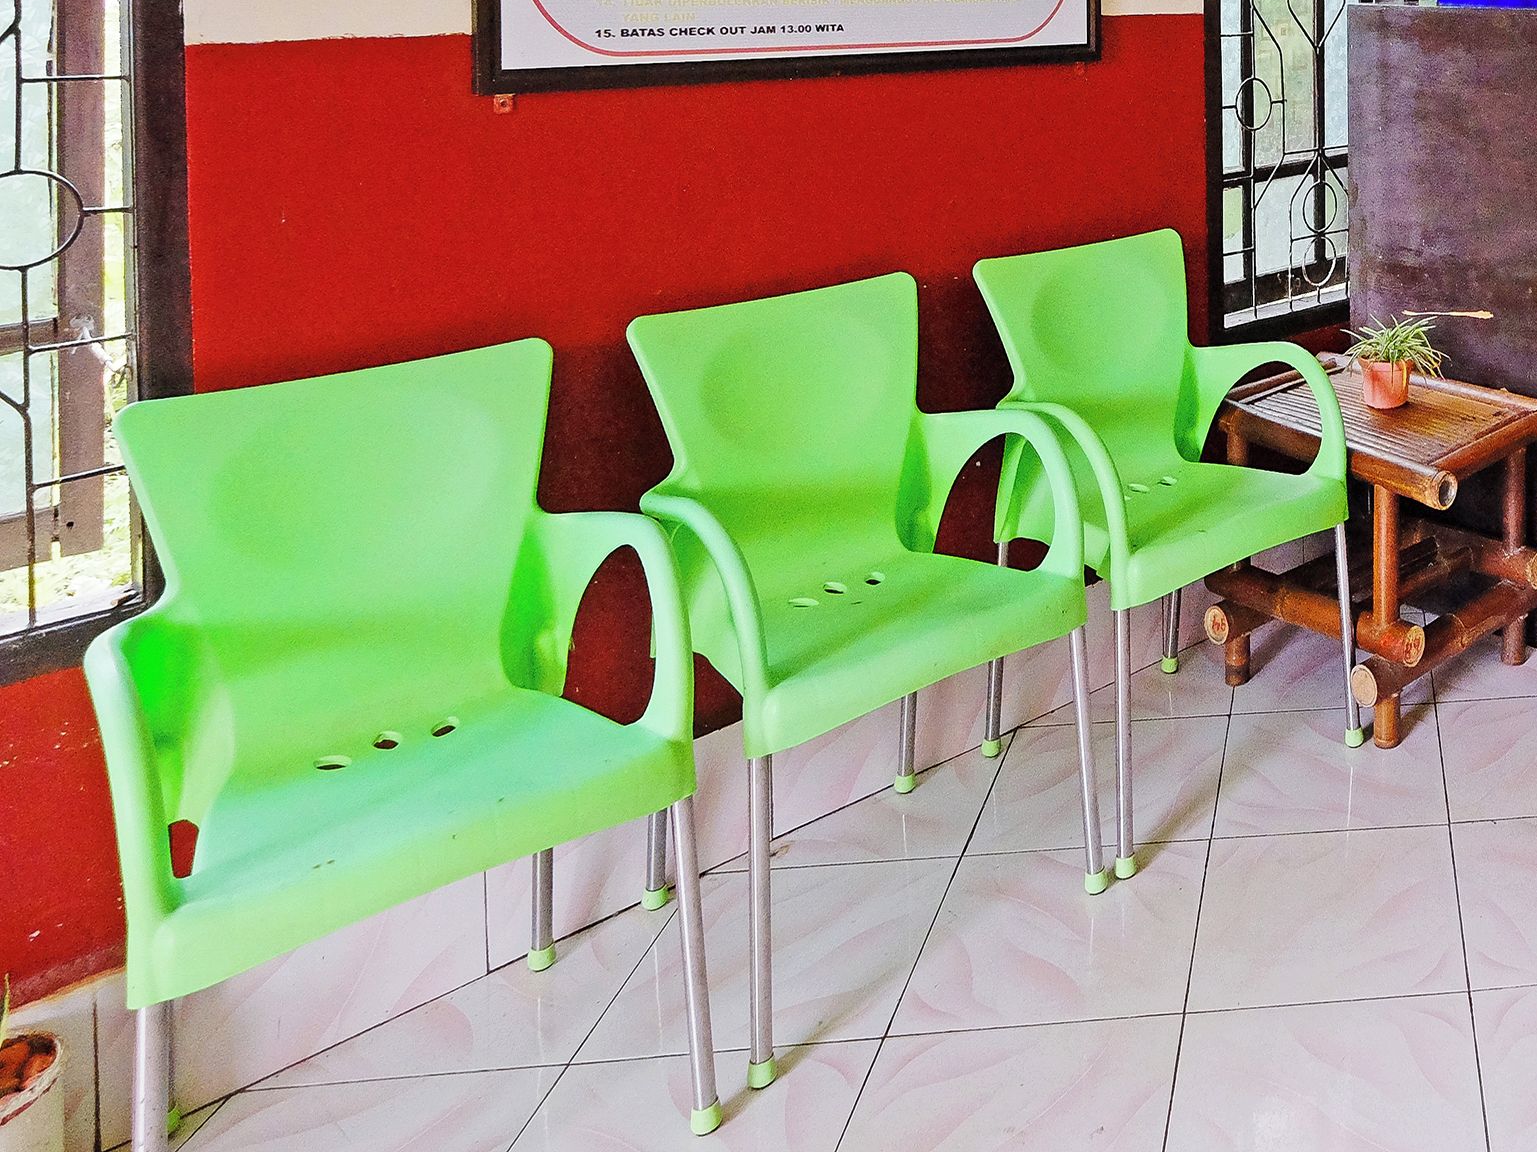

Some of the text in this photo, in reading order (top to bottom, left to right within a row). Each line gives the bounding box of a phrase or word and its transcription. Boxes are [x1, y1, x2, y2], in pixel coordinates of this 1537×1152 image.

[594, 23, 844, 39] 15. BATAS CHECK OUT JAM 13.00 WITA
